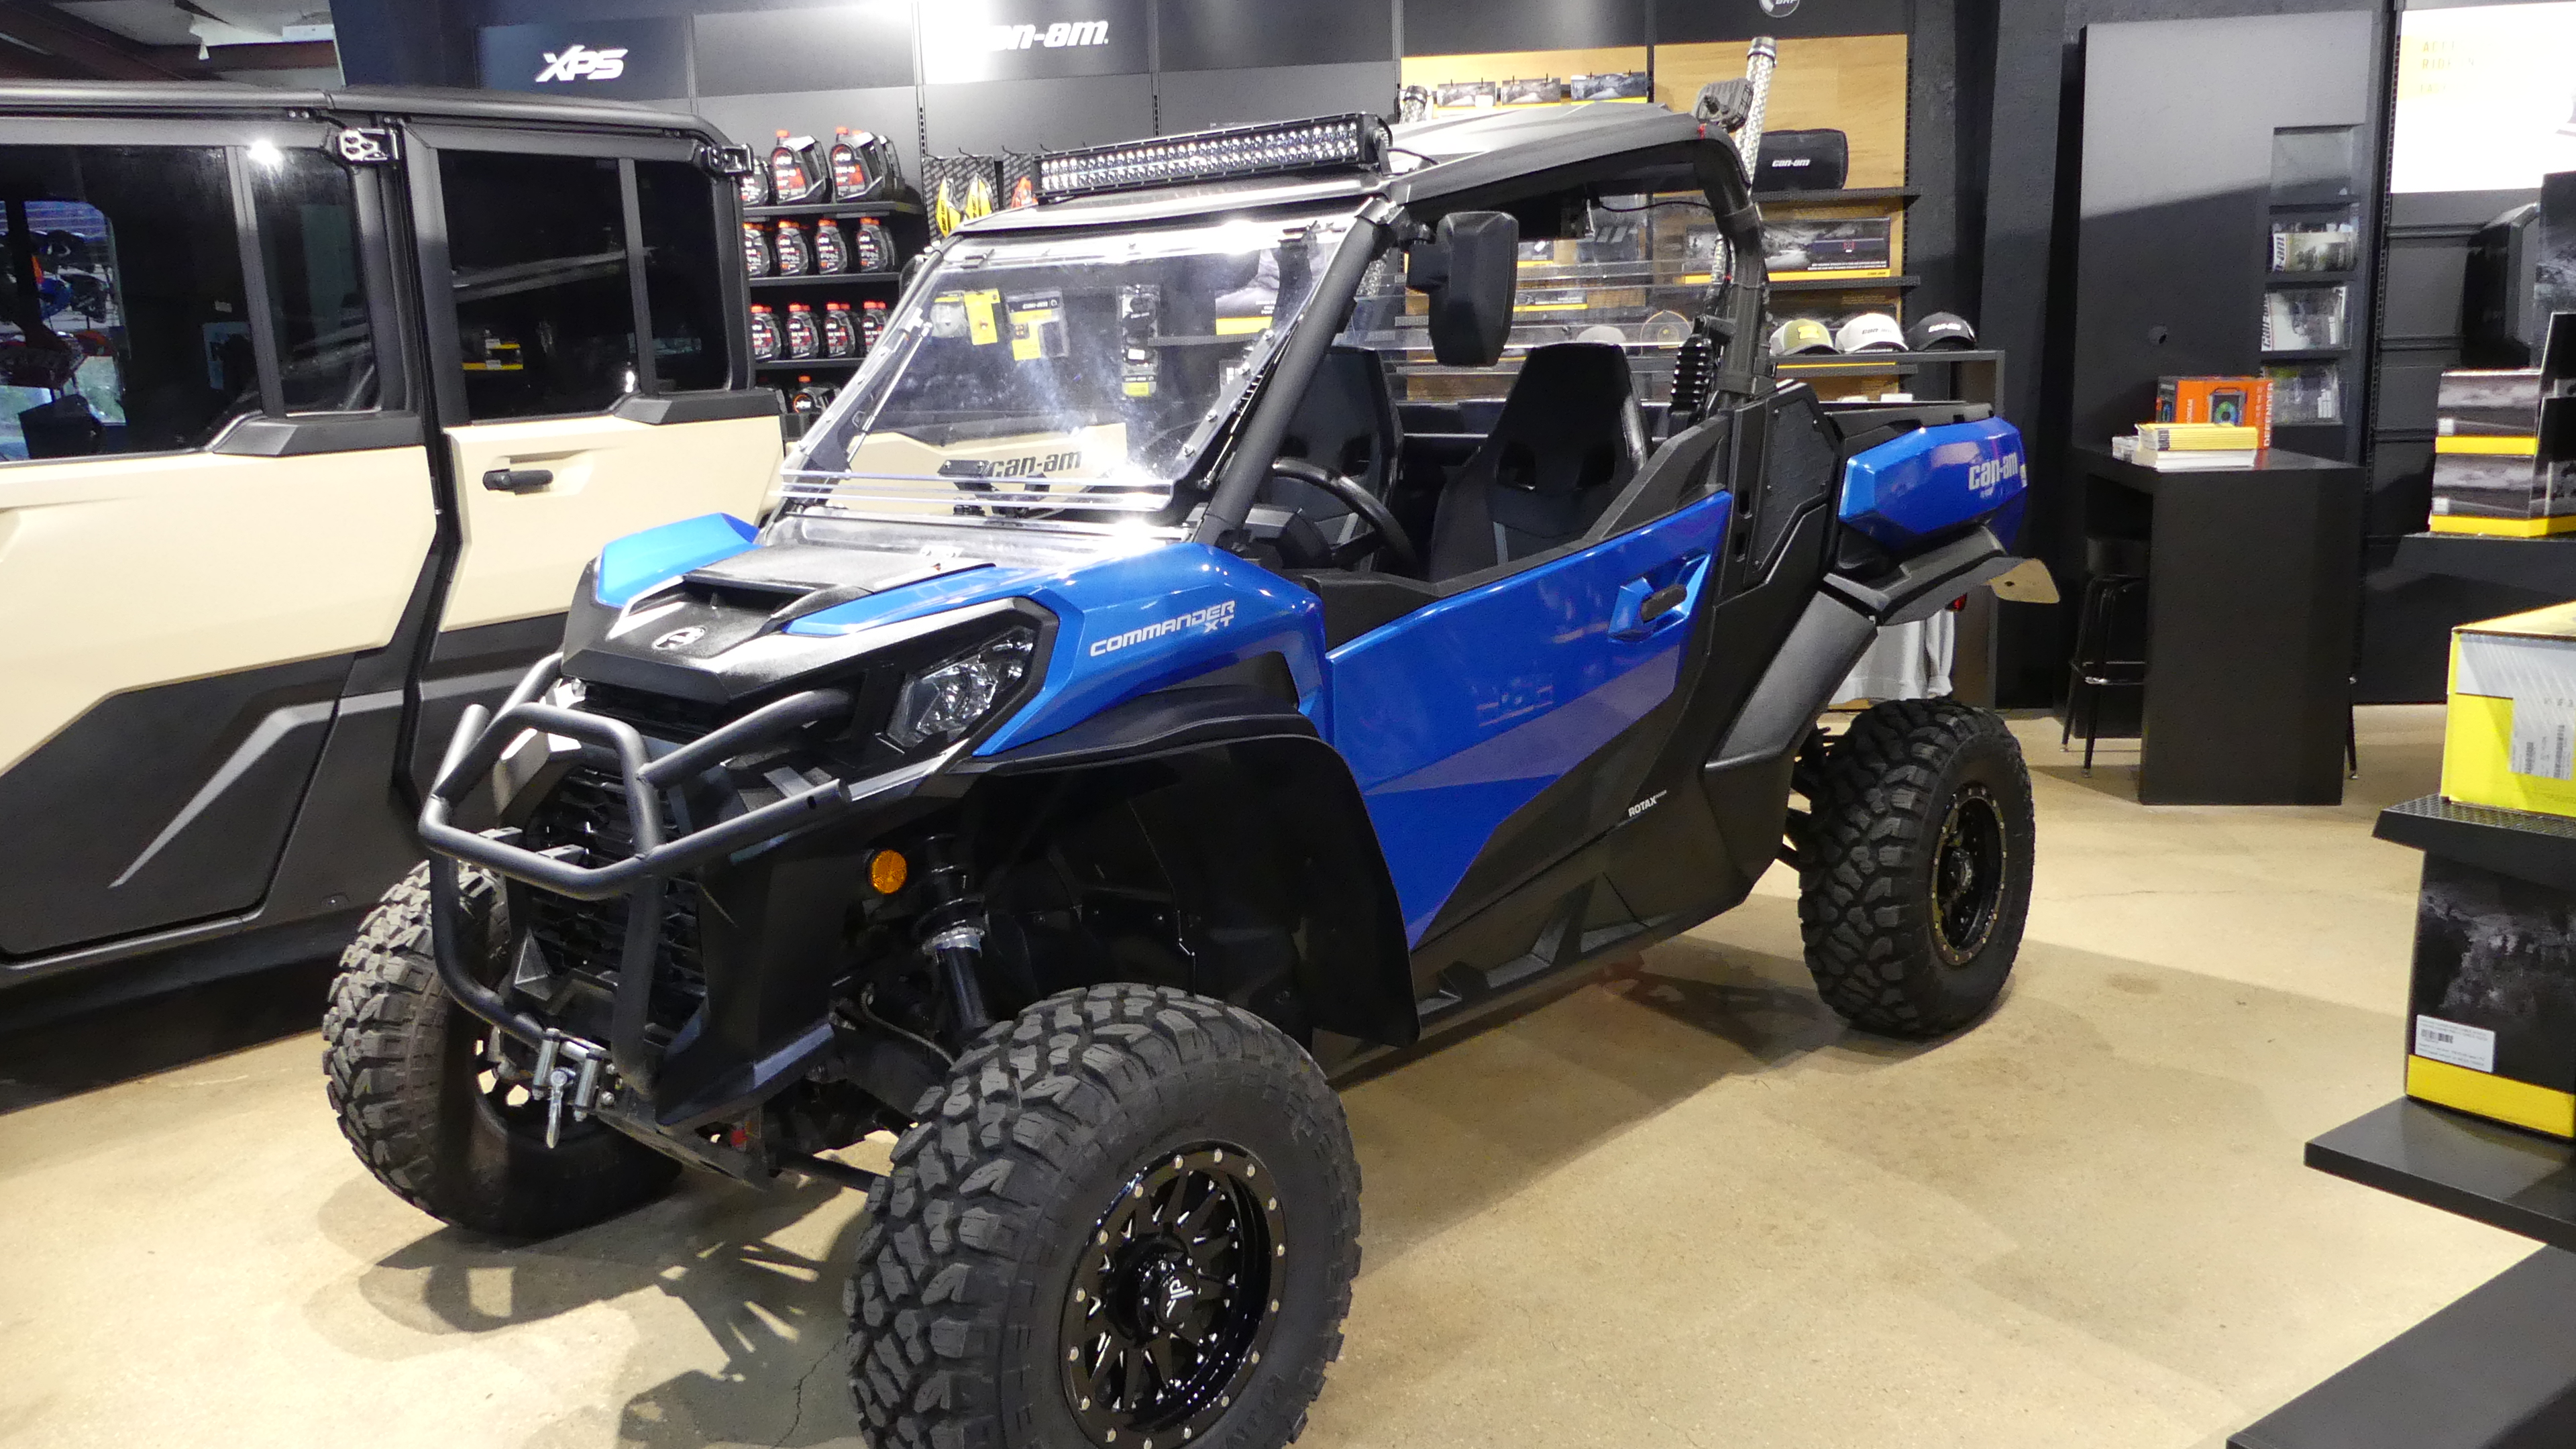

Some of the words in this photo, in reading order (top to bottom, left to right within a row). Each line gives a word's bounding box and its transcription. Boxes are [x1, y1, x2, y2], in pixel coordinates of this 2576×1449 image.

[535, 44, 629, 82] XPS
[1772, 159, 1811, 167] can-am
[2263, 382, 2274, 447] DEFENDER
[1968, 451, 2019, 490] can-am
[1090, 600, 1236, 657] COMMANDER
[1204, 614, 1235, 633] XT
[1628, 795, 1657, 817] ROTAX
